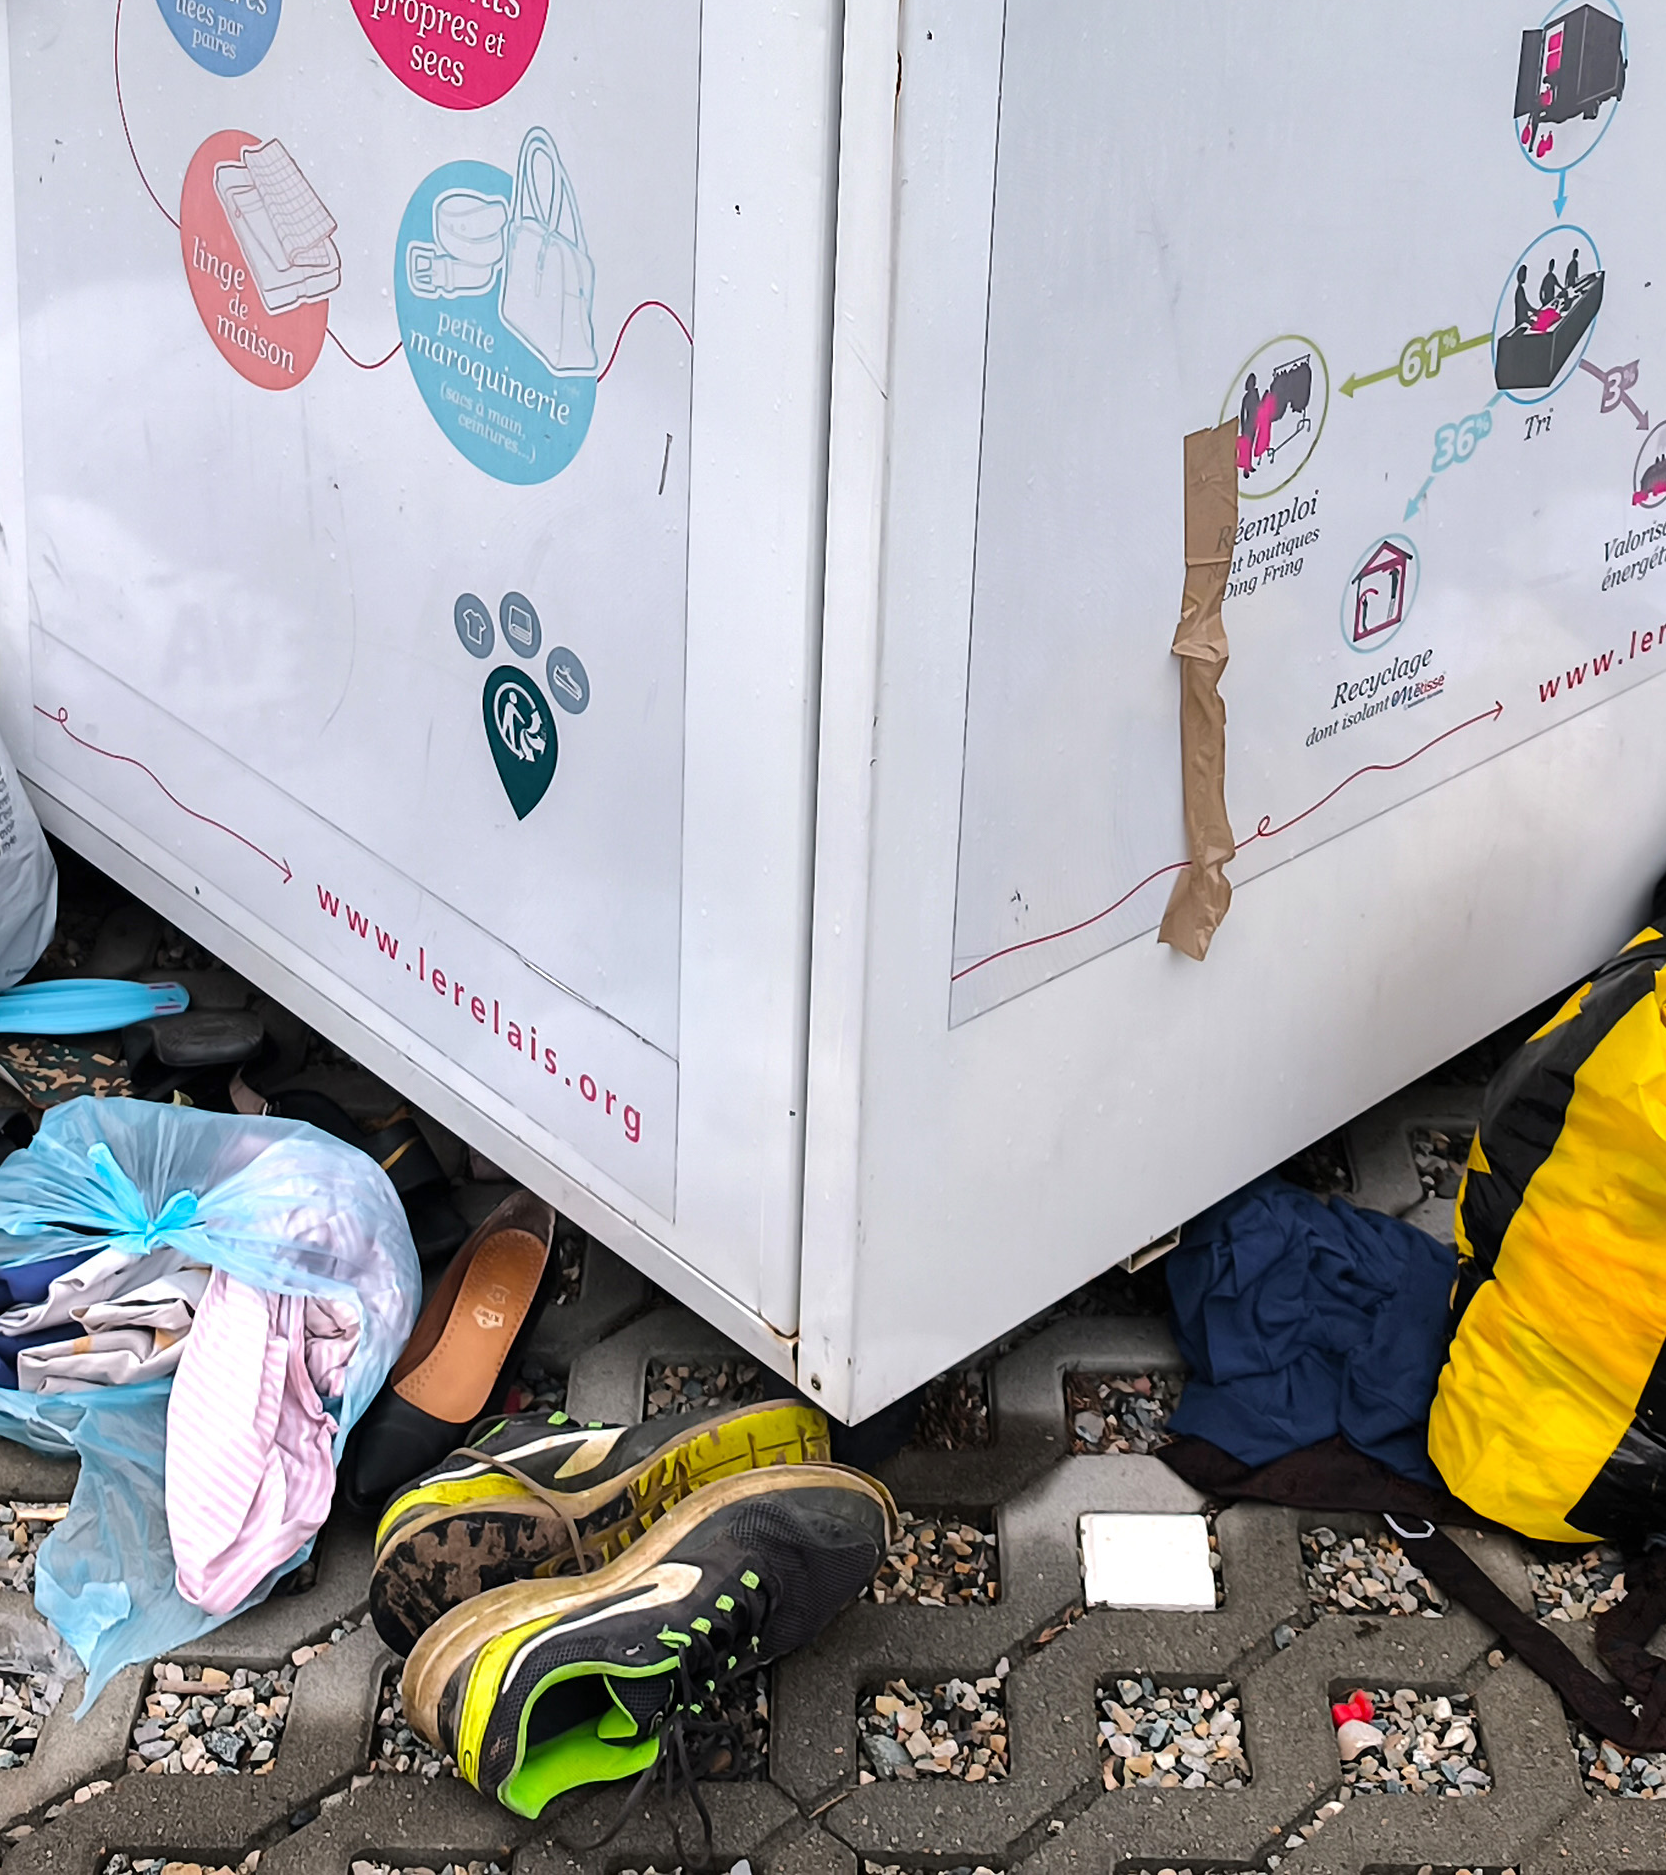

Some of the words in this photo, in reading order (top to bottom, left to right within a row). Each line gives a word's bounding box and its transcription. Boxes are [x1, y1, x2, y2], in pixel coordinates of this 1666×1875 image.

[191, 26, 237, 60] paires
[217, 13, 244, 38] par
[485, 33, 506, 58] et
[410, 45, 465, 87] secs
[192, 236, 245, 291] linge
[229, 293, 248, 320] de
[217, 315, 295, 374] maison
[436, 311, 495, 354] petite
[409, 329, 570, 426] maroquinerie
[439, 380, 473, 411] (sacs
[476, 399, 485, 416] à
[1523, 407, 1555, 441] Tri
[1247, 528, 1320, 568] boutiques
[1262, 557, 1304, 585] Fring
[1330, 648, 1433, 710] Recyclage
[1305, 720, 1339, 747] dont
[1342, 695, 1390, 730] isolant
[316, 883, 643, 1144] www.lerelais.org
